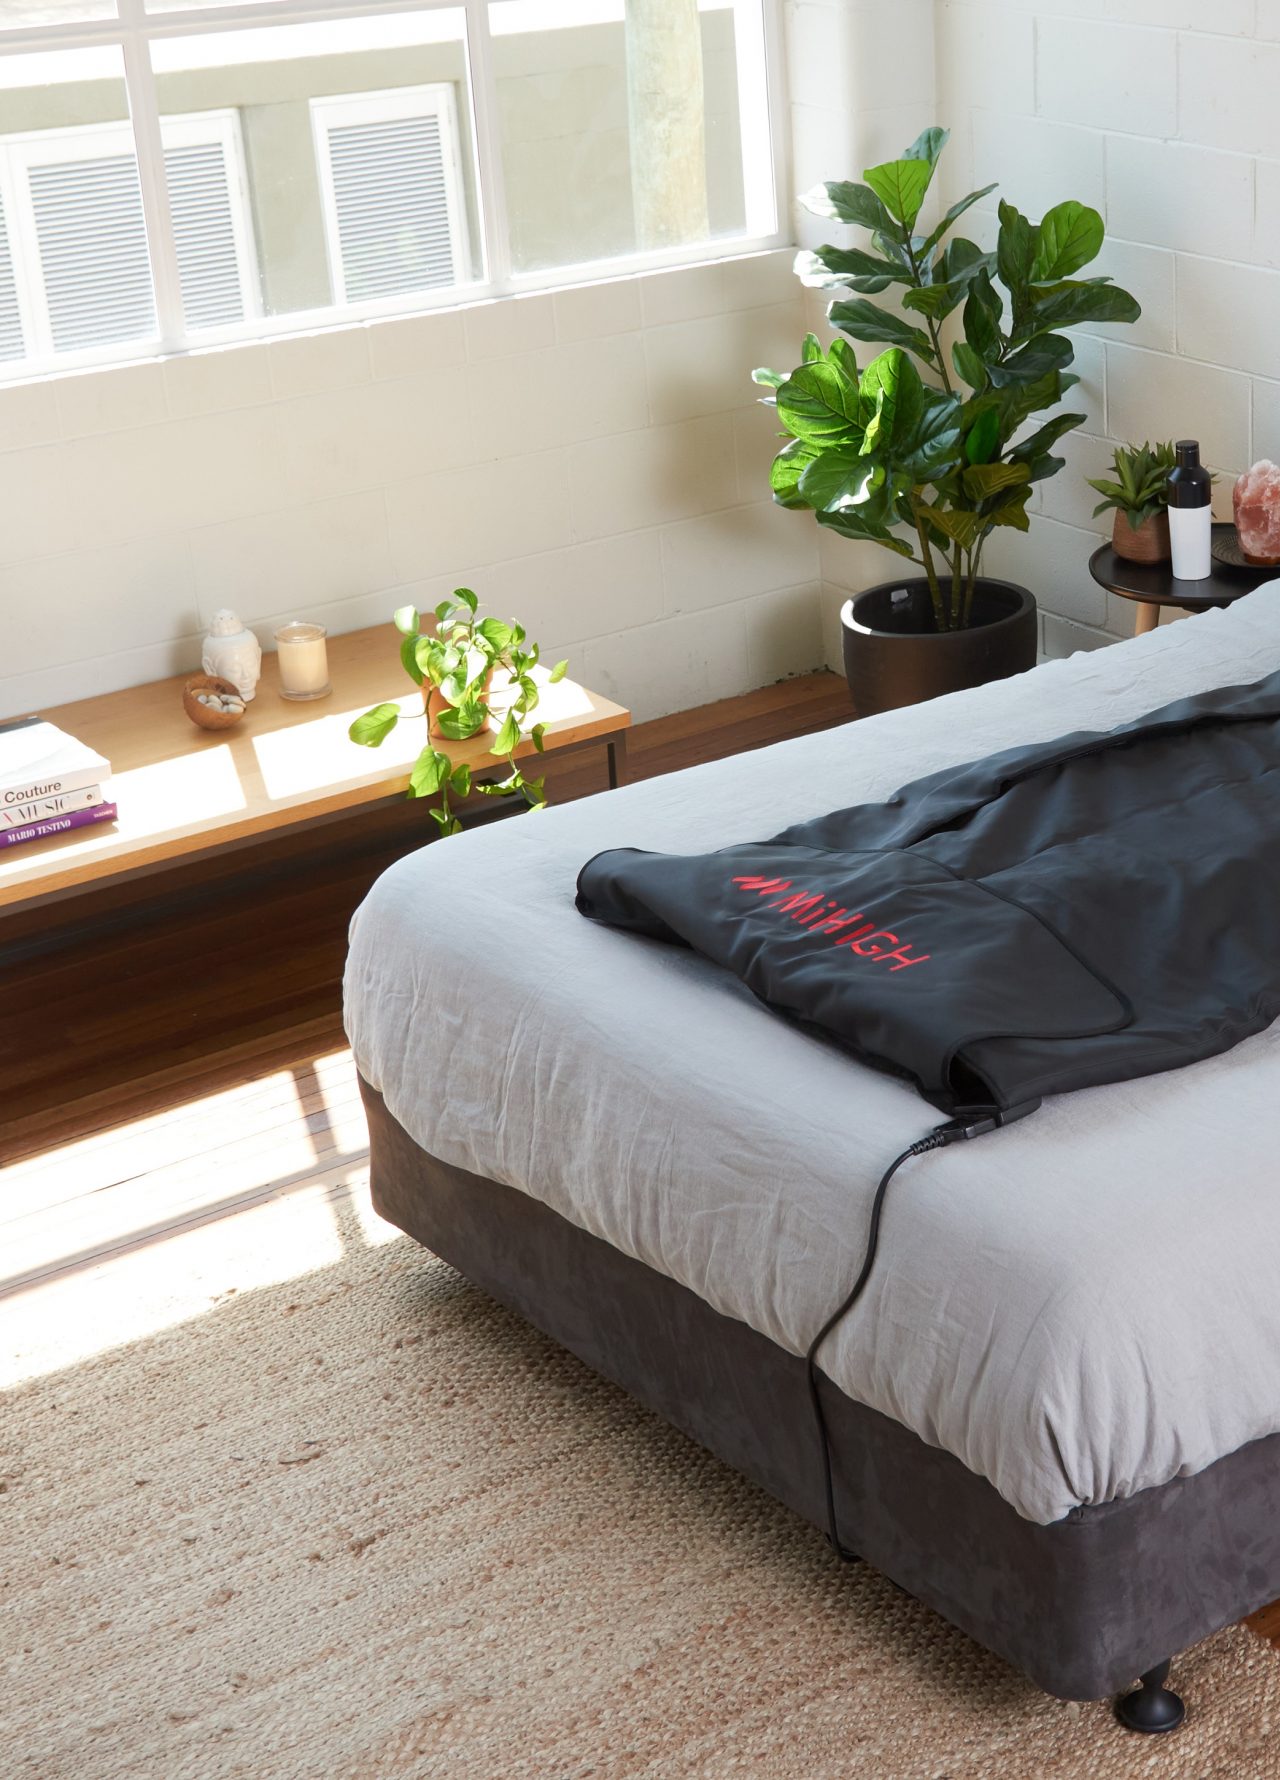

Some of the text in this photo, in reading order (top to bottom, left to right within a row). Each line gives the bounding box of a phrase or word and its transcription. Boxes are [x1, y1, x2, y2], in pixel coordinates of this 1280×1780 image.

[4, 782, 62, 803] Couture
[7, 819, 71, 843] MARIO TESTINO
